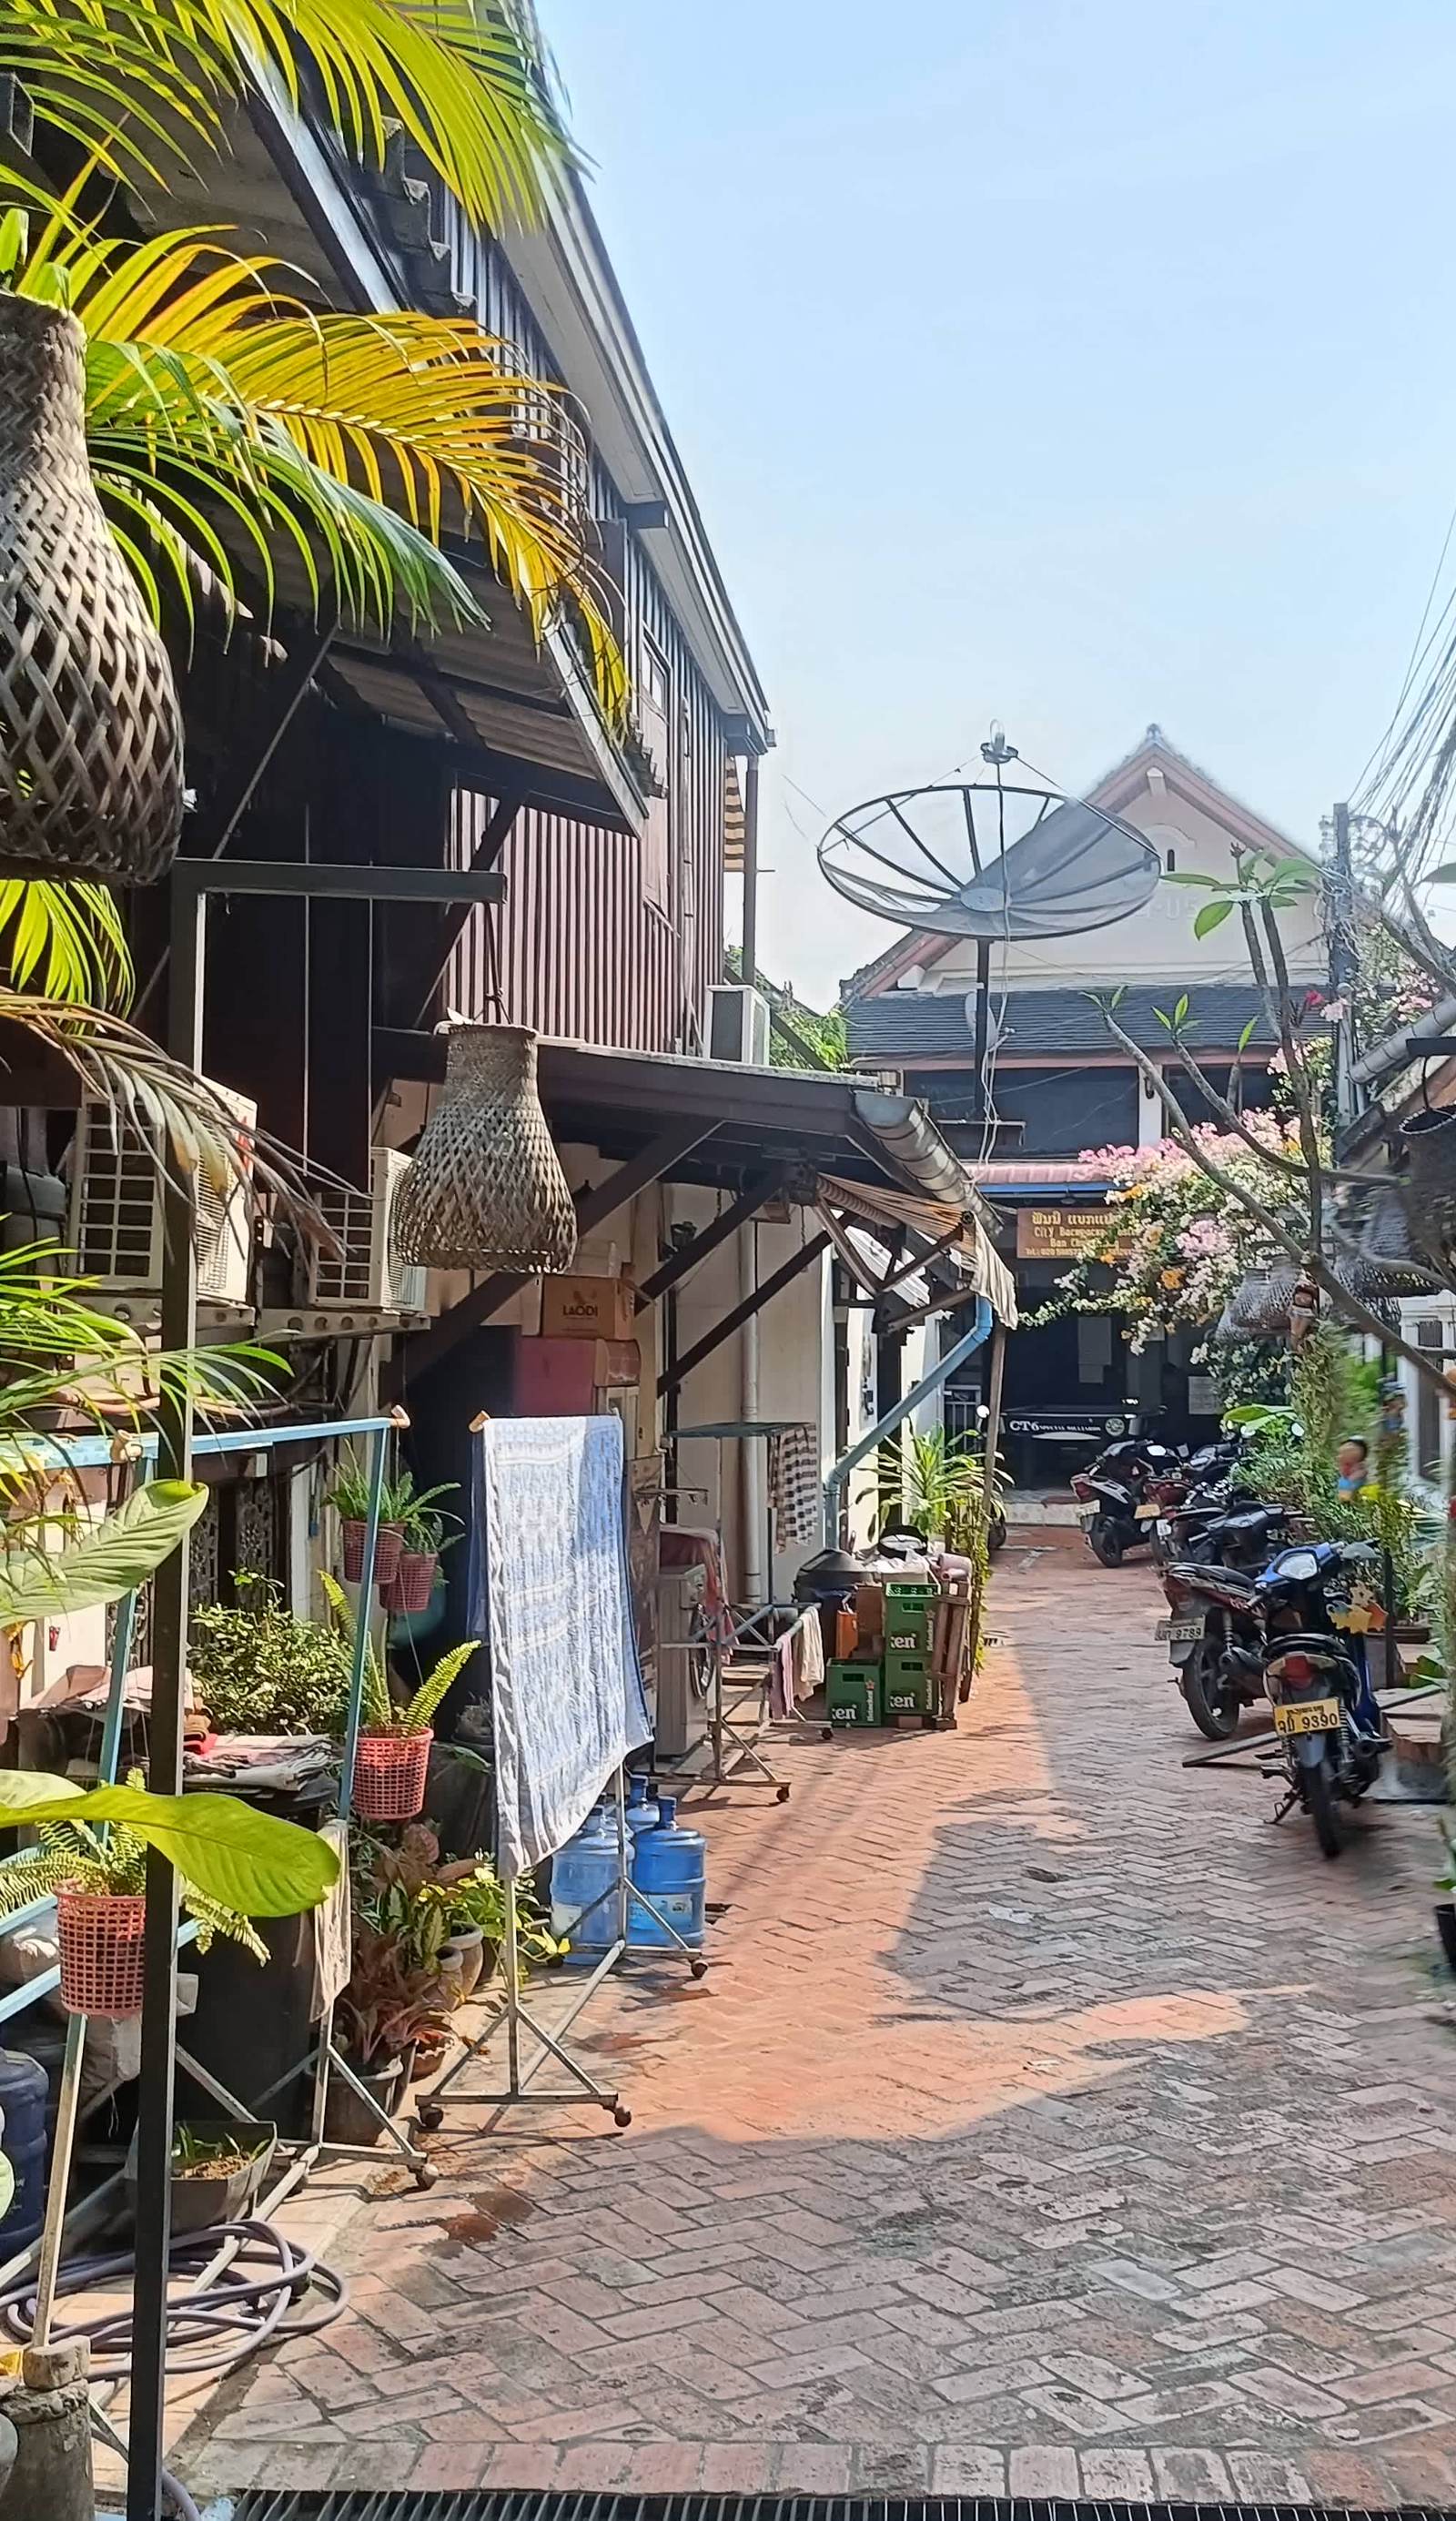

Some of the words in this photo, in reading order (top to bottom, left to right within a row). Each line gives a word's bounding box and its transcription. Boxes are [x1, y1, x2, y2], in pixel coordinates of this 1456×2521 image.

[1034, 1226, 1055, 1238] City
[563, 1305, 598, 1317] LAODI
[1009, 1421, 1039, 1431] CT6
[1301, 1713, 1337, 1729] 9390
